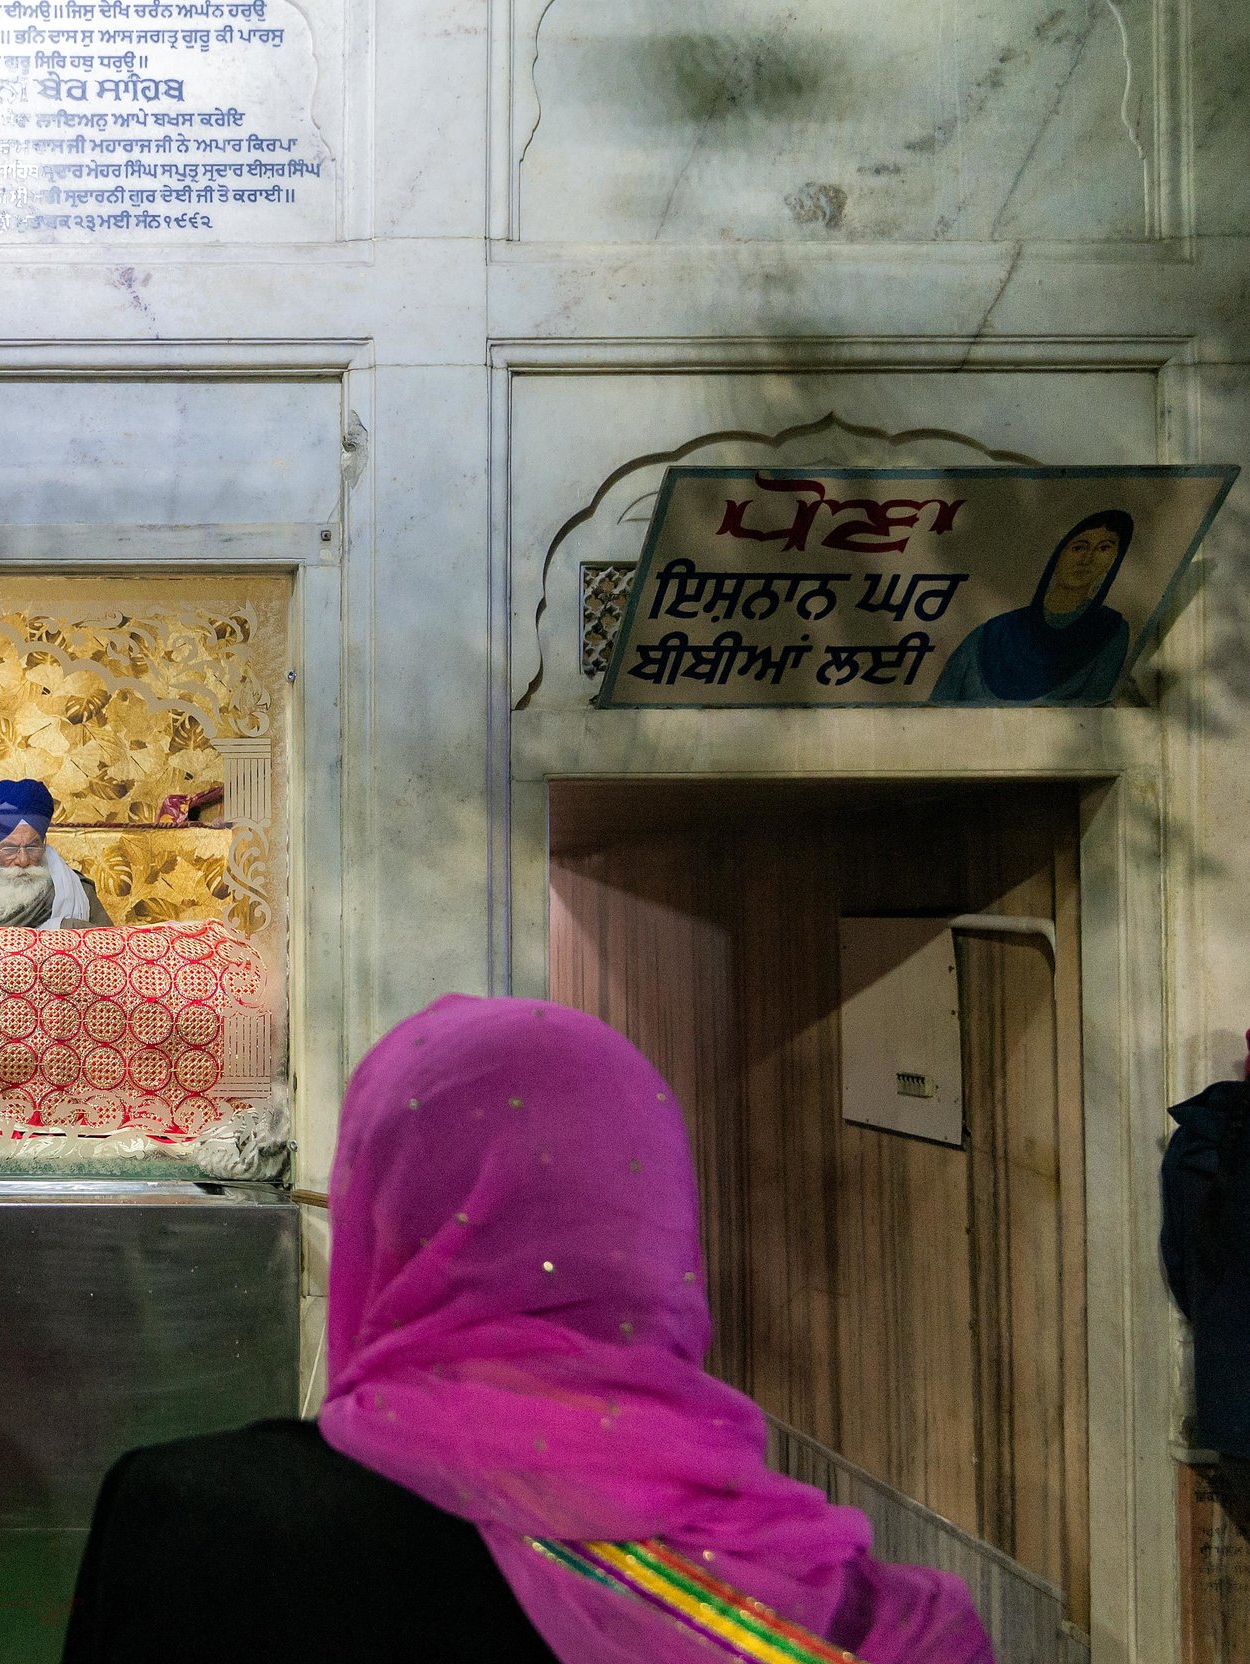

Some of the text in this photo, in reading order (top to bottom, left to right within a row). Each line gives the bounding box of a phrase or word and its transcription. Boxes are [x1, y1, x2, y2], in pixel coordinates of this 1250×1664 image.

[66, 0, 94, 21] ਜਿਸੁ
[99, 0, 129, 19] ਦੇਖਿ
[14, 25, 45, 44] ਭਨਿ
[48, 30, 78, 44] ਦਾਸ
[98, 30, 133, 44] ਆਸ
[182, 29, 210, 51] ਗੁਰੂ
[215, 25, 233, 43] ਕੀ
[238, 29, 284, 47] ਪਾਰਸੁ
[35, 51, 67, 69] ਸਿਰਿ
[34, 72, 89, 101] ਬੇਰ
[96, 72, 185, 102] ਸਾਹਿਬ
[112, 108, 148, 127] ਆਪੇ
[151, 113, 195, 127] ਬਖਸ
[67, 134, 86, 154] ਜੀ
[90, 139, 152, 153] ਮਹਾਰਾਜ
[155, 135, 172, 153] ਜੀ
[176, 134, 192, 153] ਨੇ
[195, 139, 243, 153] ਅਪਾਰ
[247, 134, 297, 152] ਕਿਰਪਾ
[85, 160, 122, 179] ਮੇਹਰ
[124, 159, 157, 179] ਸਿੰਘ
[287, 159, 321, 178] ਸਿੰਘ
[128, 190, 157, 207] ਗੁਰ
[160, 185, 194, 203] ਦੇਈ
[196, 185, 215, 203] ਜੀ
[75, 215, 96, 232] ੨੩
[98, 210, 131, 229] ਮਈ
[134, 210, 162, 229] ਸੰਨ
[164, 212, 213, 229] ੧੯੬੨
[648, 558, 968, 623] ਇਸ਼ਨਾਨ ਘਰ
[626, 630, 936, 685] ਬੀਬੀਆਂ ਲਈ
